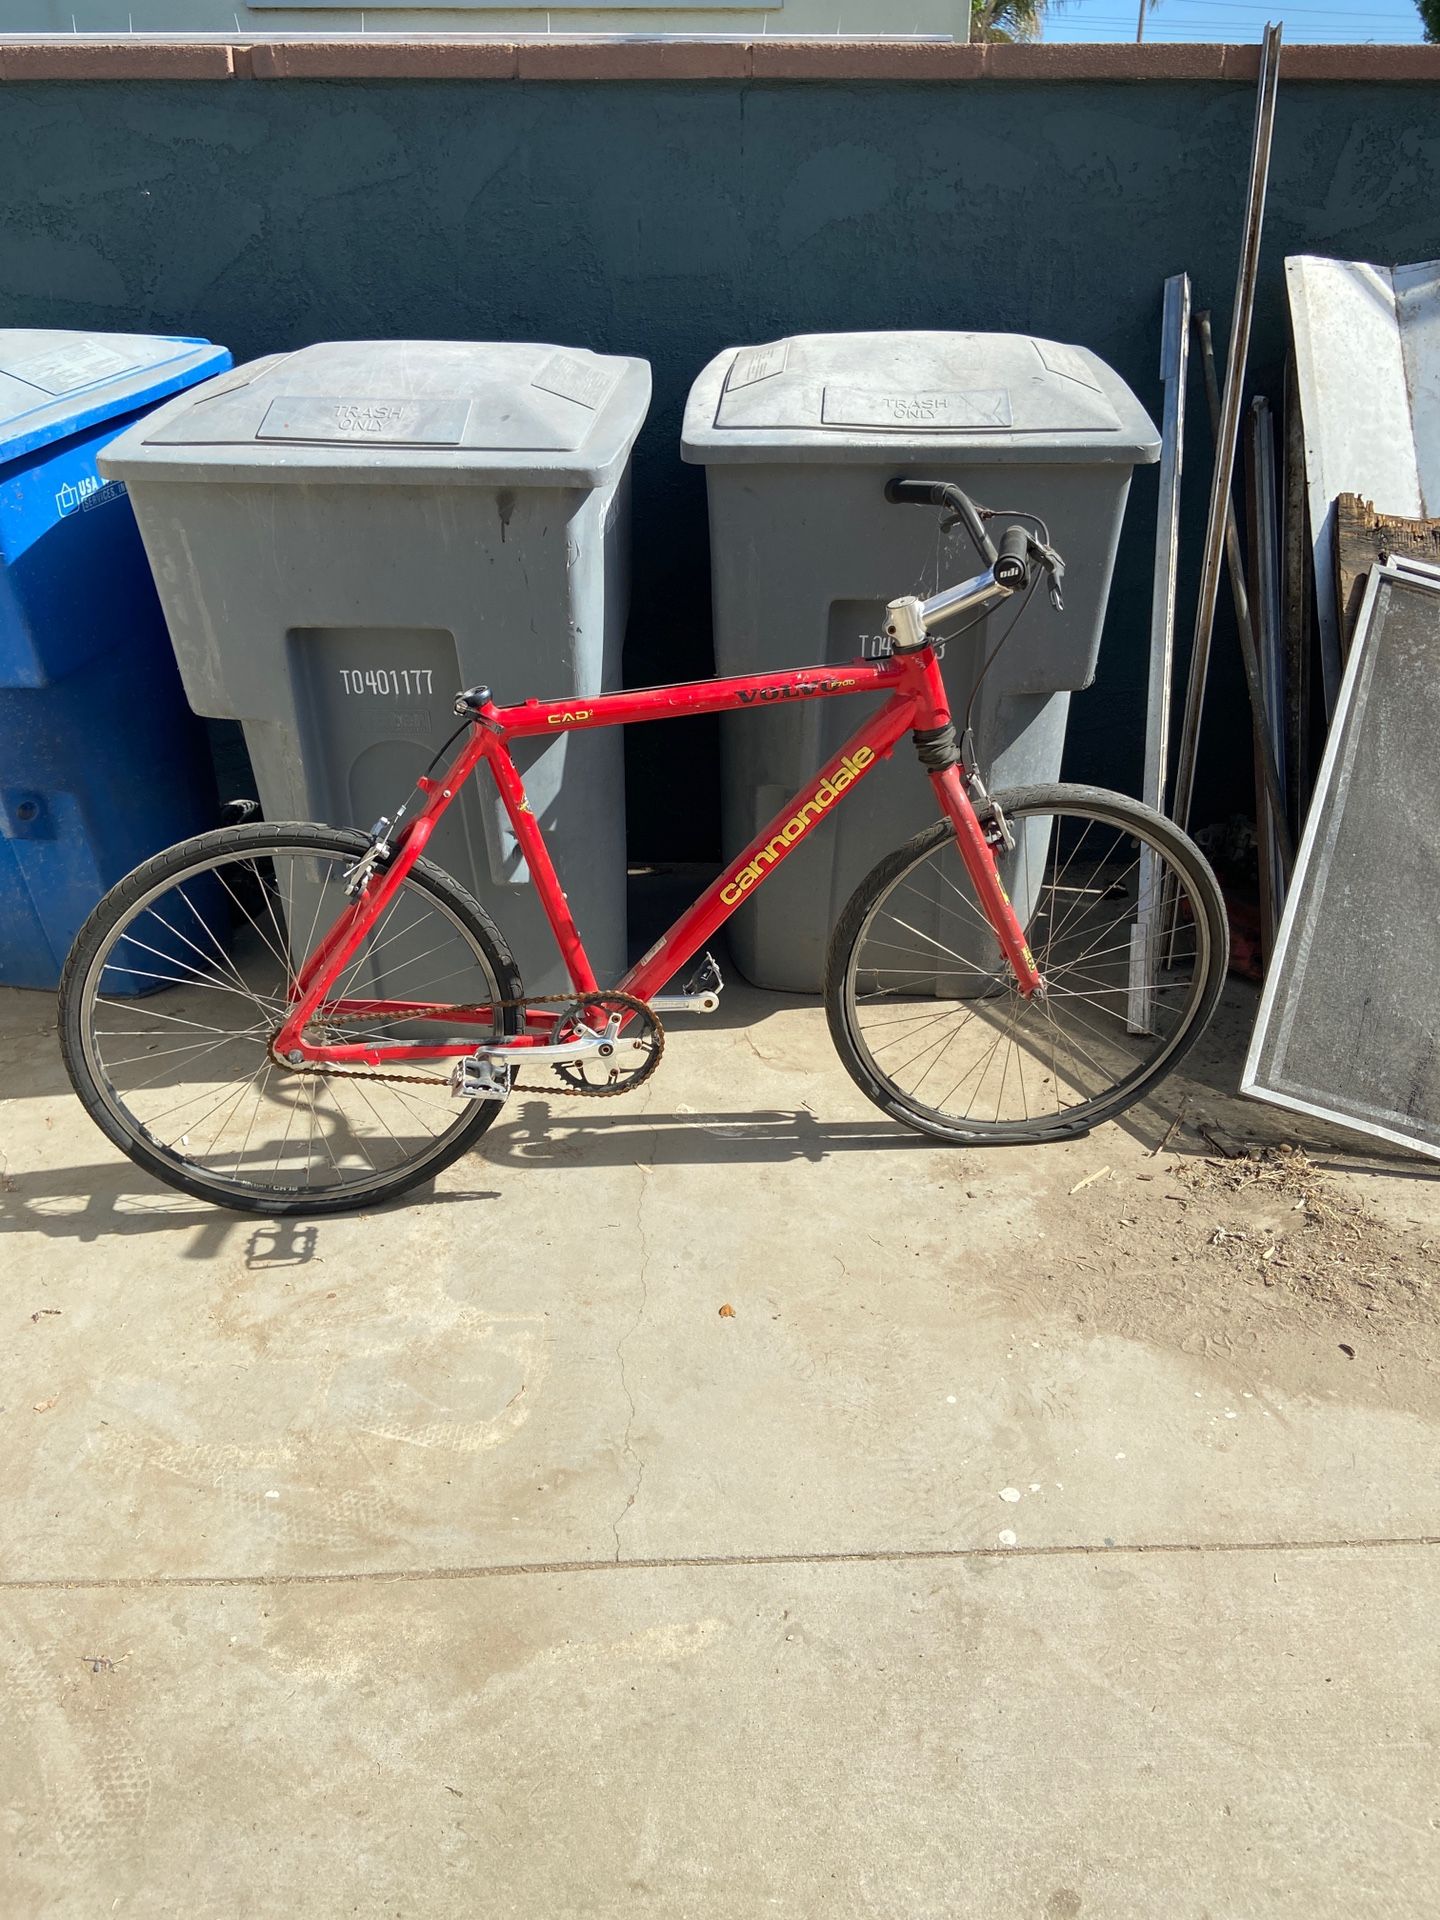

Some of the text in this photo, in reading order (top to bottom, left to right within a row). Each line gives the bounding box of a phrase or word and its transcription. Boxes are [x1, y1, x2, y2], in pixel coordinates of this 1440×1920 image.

[334, 404, 404, 419] TRASH
[882, 398, 947, 410] TRASH
[893, 409, 937, 419] ONLY
[338, 419, 388, 432] ONLY
[78, 475, 98, 496] USA
[735, 678, 839, 704] VOLVO
[719, 745, 875, 906] cannondale
